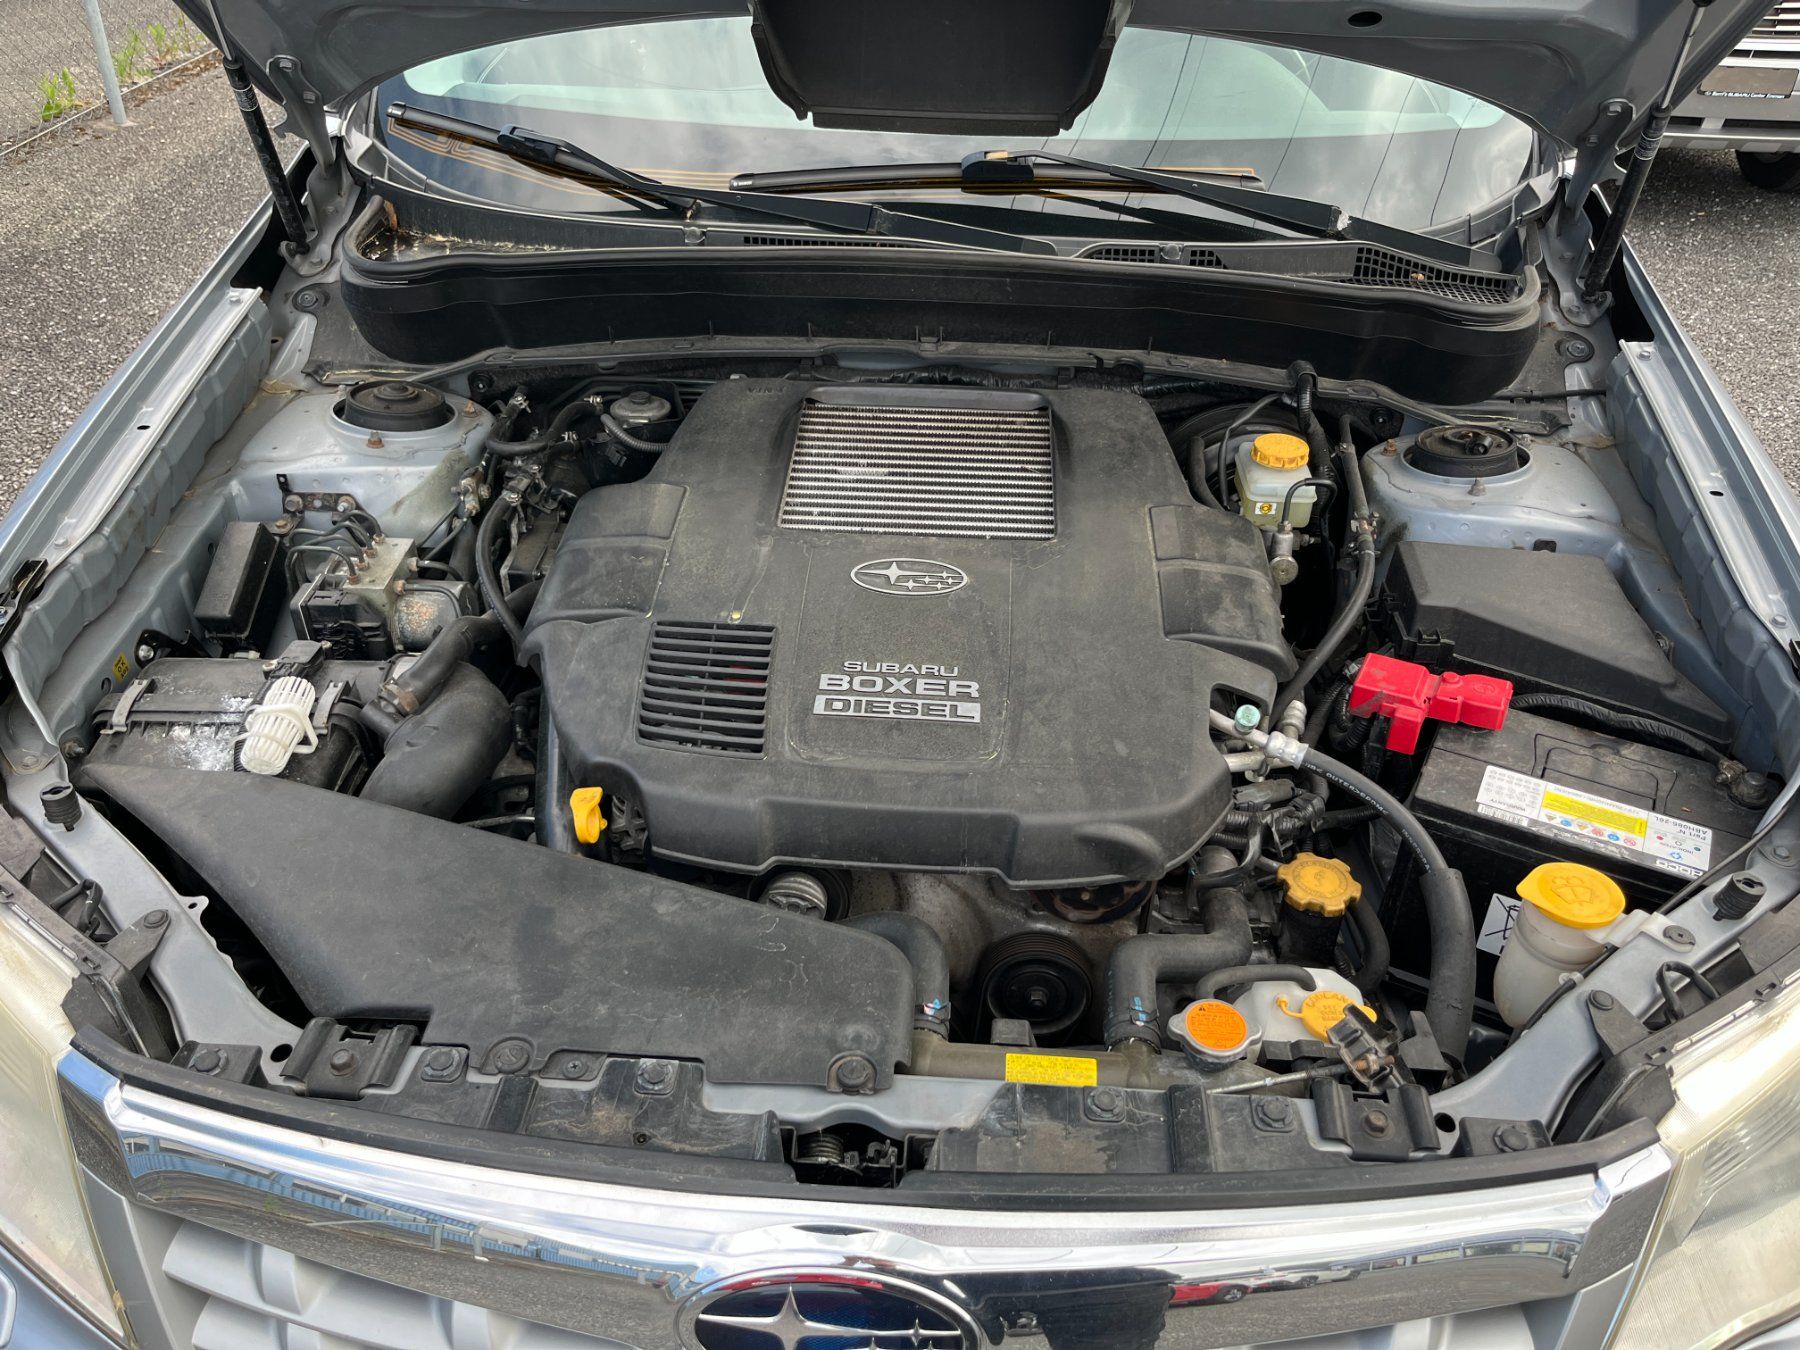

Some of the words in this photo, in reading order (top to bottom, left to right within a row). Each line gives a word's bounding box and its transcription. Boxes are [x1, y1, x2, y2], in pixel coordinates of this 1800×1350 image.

[843, 661, 959, 677] SUBARU
[818, 673, 980, 698] BOXER
[823, 697, 976, 720] DIESEL
